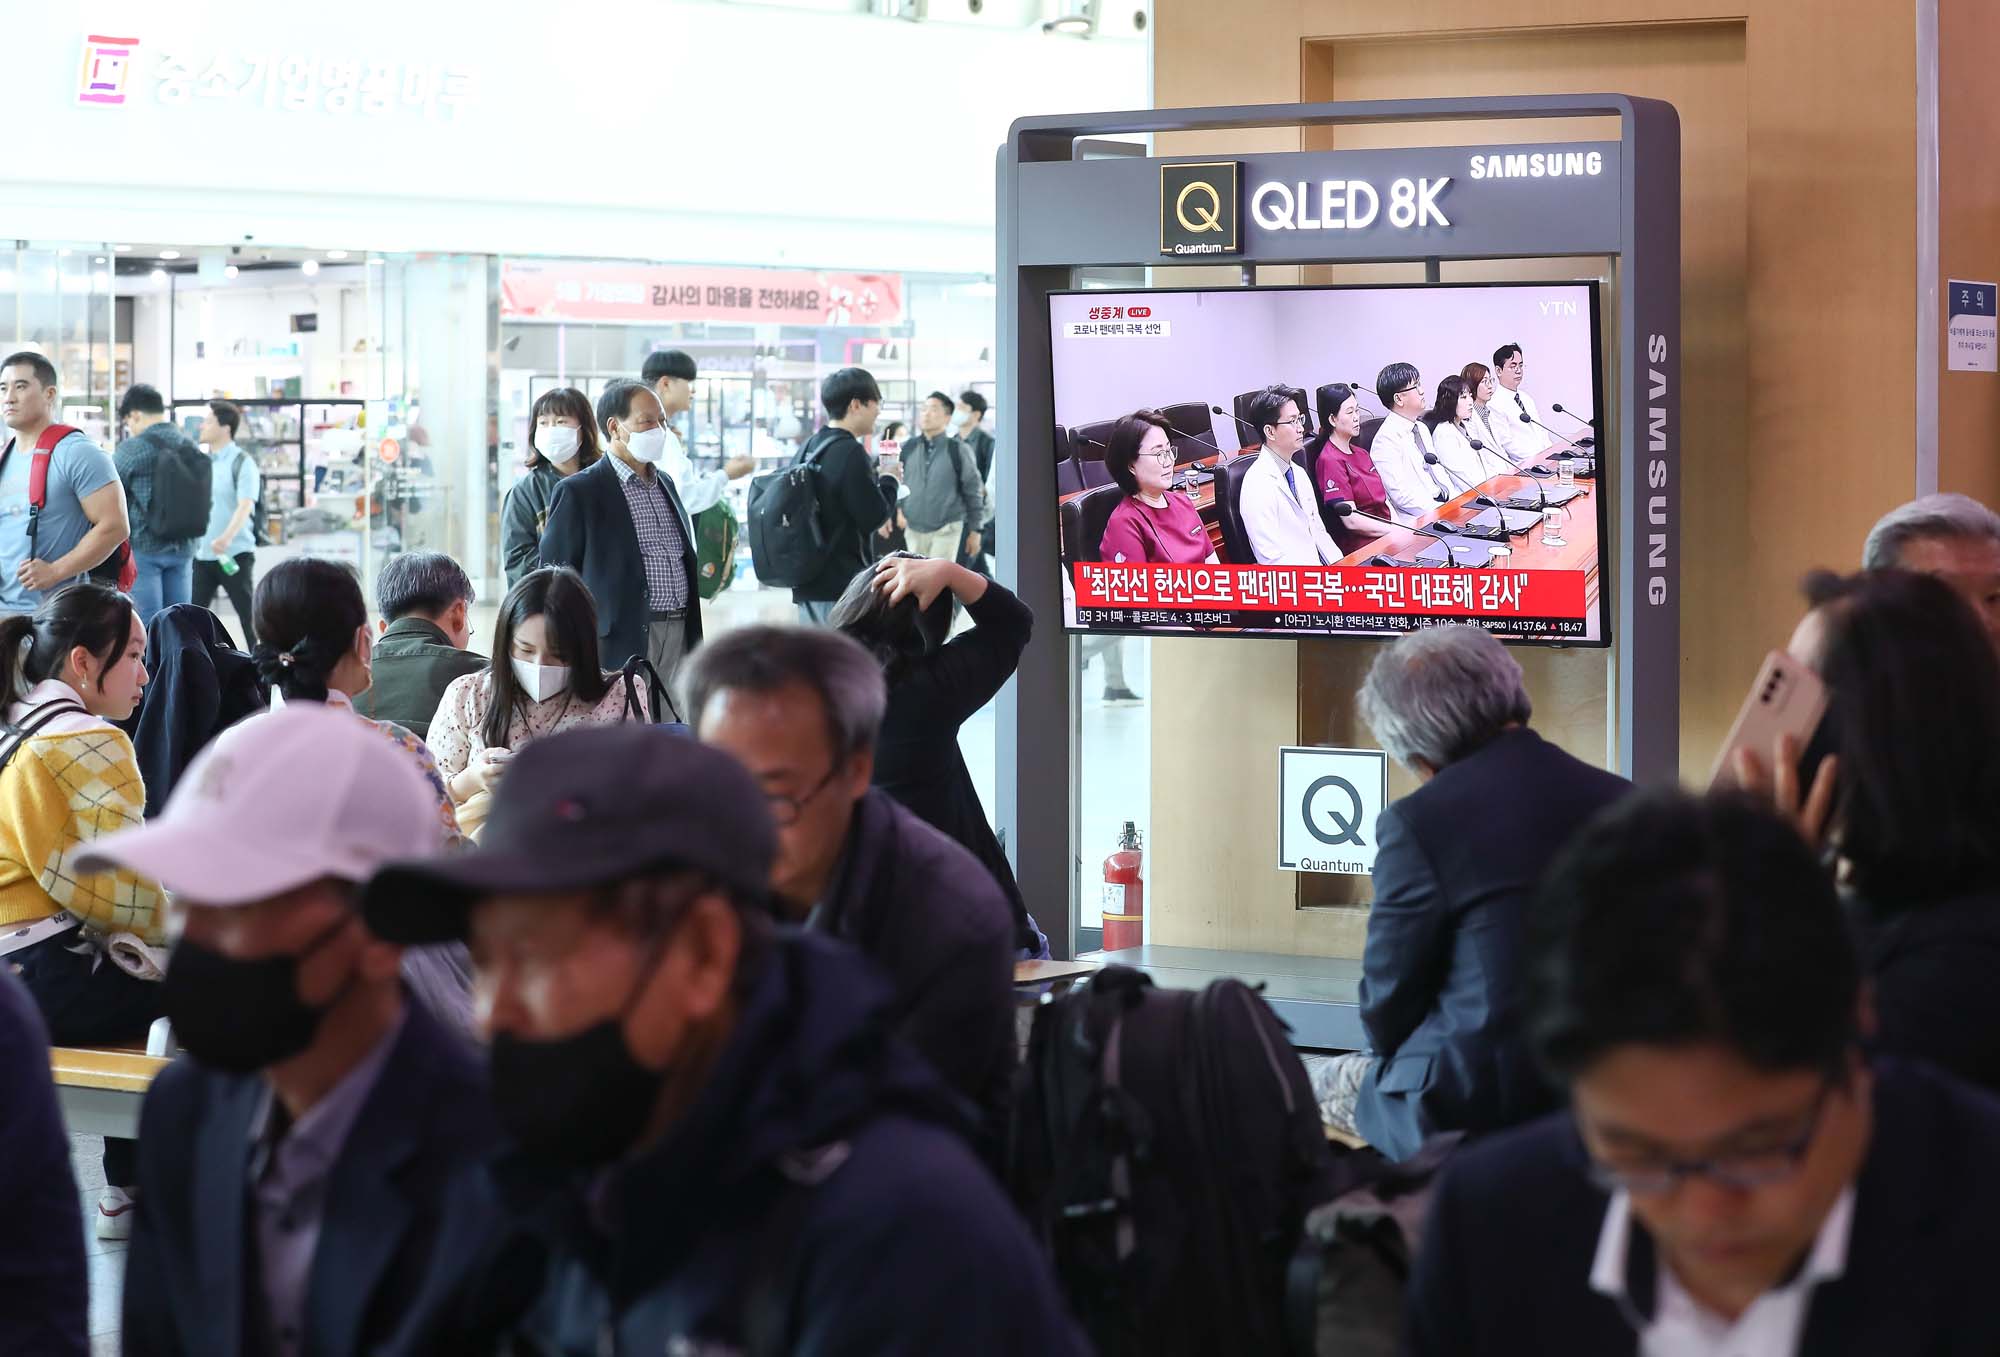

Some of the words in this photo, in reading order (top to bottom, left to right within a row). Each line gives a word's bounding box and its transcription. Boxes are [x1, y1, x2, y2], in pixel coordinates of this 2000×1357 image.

[1470, 151, 1602, 179] SAMSUNG
[1175, 181, 1224, 233] Q
[1251, 179, 1379, 231] QLED
[1388, 177, 1452, 228] 8K
[1175, 242, 1222, 255] Quantum
[651, 284, 702, 306] 감사의
[706, 285, 753, 308] 마음을
[758, 288, 820, 310] 전하세요
[1088, 306, 1124, 320] 생중계
[1131, 308, 1147, 316] LIVE
[1538, 301, 1577, 315] YTN
[1073, 324, 1098, 335] 코로나
[1099, 323, 1124, 335] 팬데믹
[1126, 323, 1143, 335] 극복
[1144, 323, 1161, 335] 선언
[1648, 334, 1667, 606] SAMSUNG
[1083, 565, 1150, 602] "최전선
[1153, 567, 1234, 603] 헌신으로
[1237, 569, 1298, 606] 팬데믹
[1411, 571, 1474, 609] 대표해
[1479, 573, 1528, 611] 감사"
[1194, 612, 1232, 624] 피츠버그
[1284, 613, 1311, 627] [야구]
[1388, 616, 1411, 630] 한화,
[1413, 616, 1433, 630] 시즌
[1481, 621, 1507, 629] S&P500
[1512, 621, 1547, 631] 4137.64
[1559, 622, 1583, 632] 18.47
[1301, 775, 1367, 846] Q
[1300, 857, 1364, 873] Quantum
